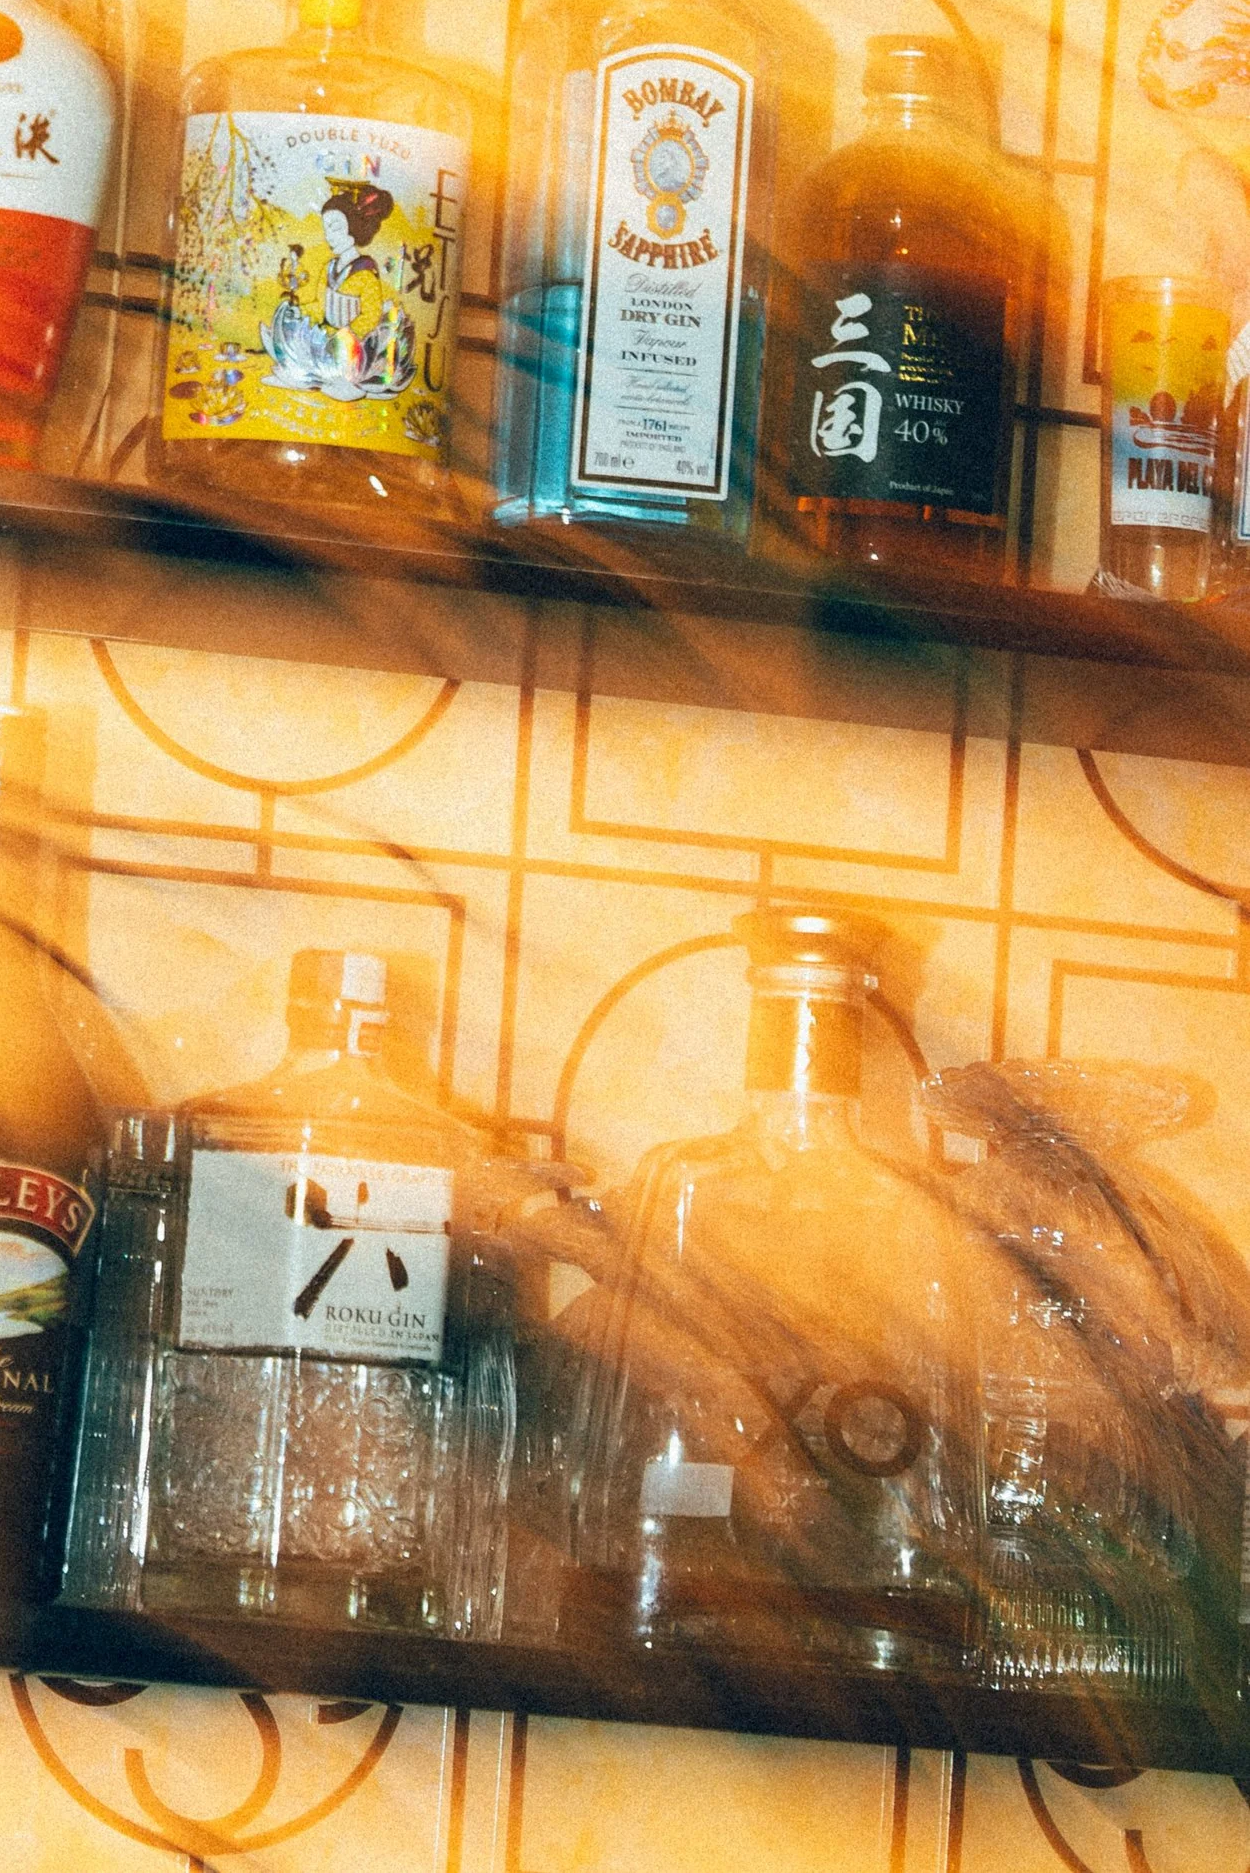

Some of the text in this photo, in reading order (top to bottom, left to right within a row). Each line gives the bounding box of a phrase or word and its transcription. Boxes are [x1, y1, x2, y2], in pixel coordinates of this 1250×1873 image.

[621, 77, 726, 128] BOMBAY
[286, 126, 412, 161] DOUBLE YUZU
[315, 152, 382, 178] GIN
[607, 218, 719, 270] SAPPHIRE
[624, 272, 702, 300] Distilled
[630, 297, 694, 311] LONDON
[619, 308, 702, 329] DRY GIN
[629, 329, 687, 352] Vapour
[620, 349, 698, 367] INFUSED
[810, 292, 893, 464] 三国
[895, 393, 966, 415] WHISKY
[626, 430, 682, 443] IMPORTED
[642, 418, 668, 432] 1761
[894, 418, 948, 447] 40%
[1127, 457, 1175, 492] PLAYA
[1176, 460, 1201, 496] DEL
[325, 1304, 428, 1331] ROKU GIN
[749, 1378, 924, 1478] XO
